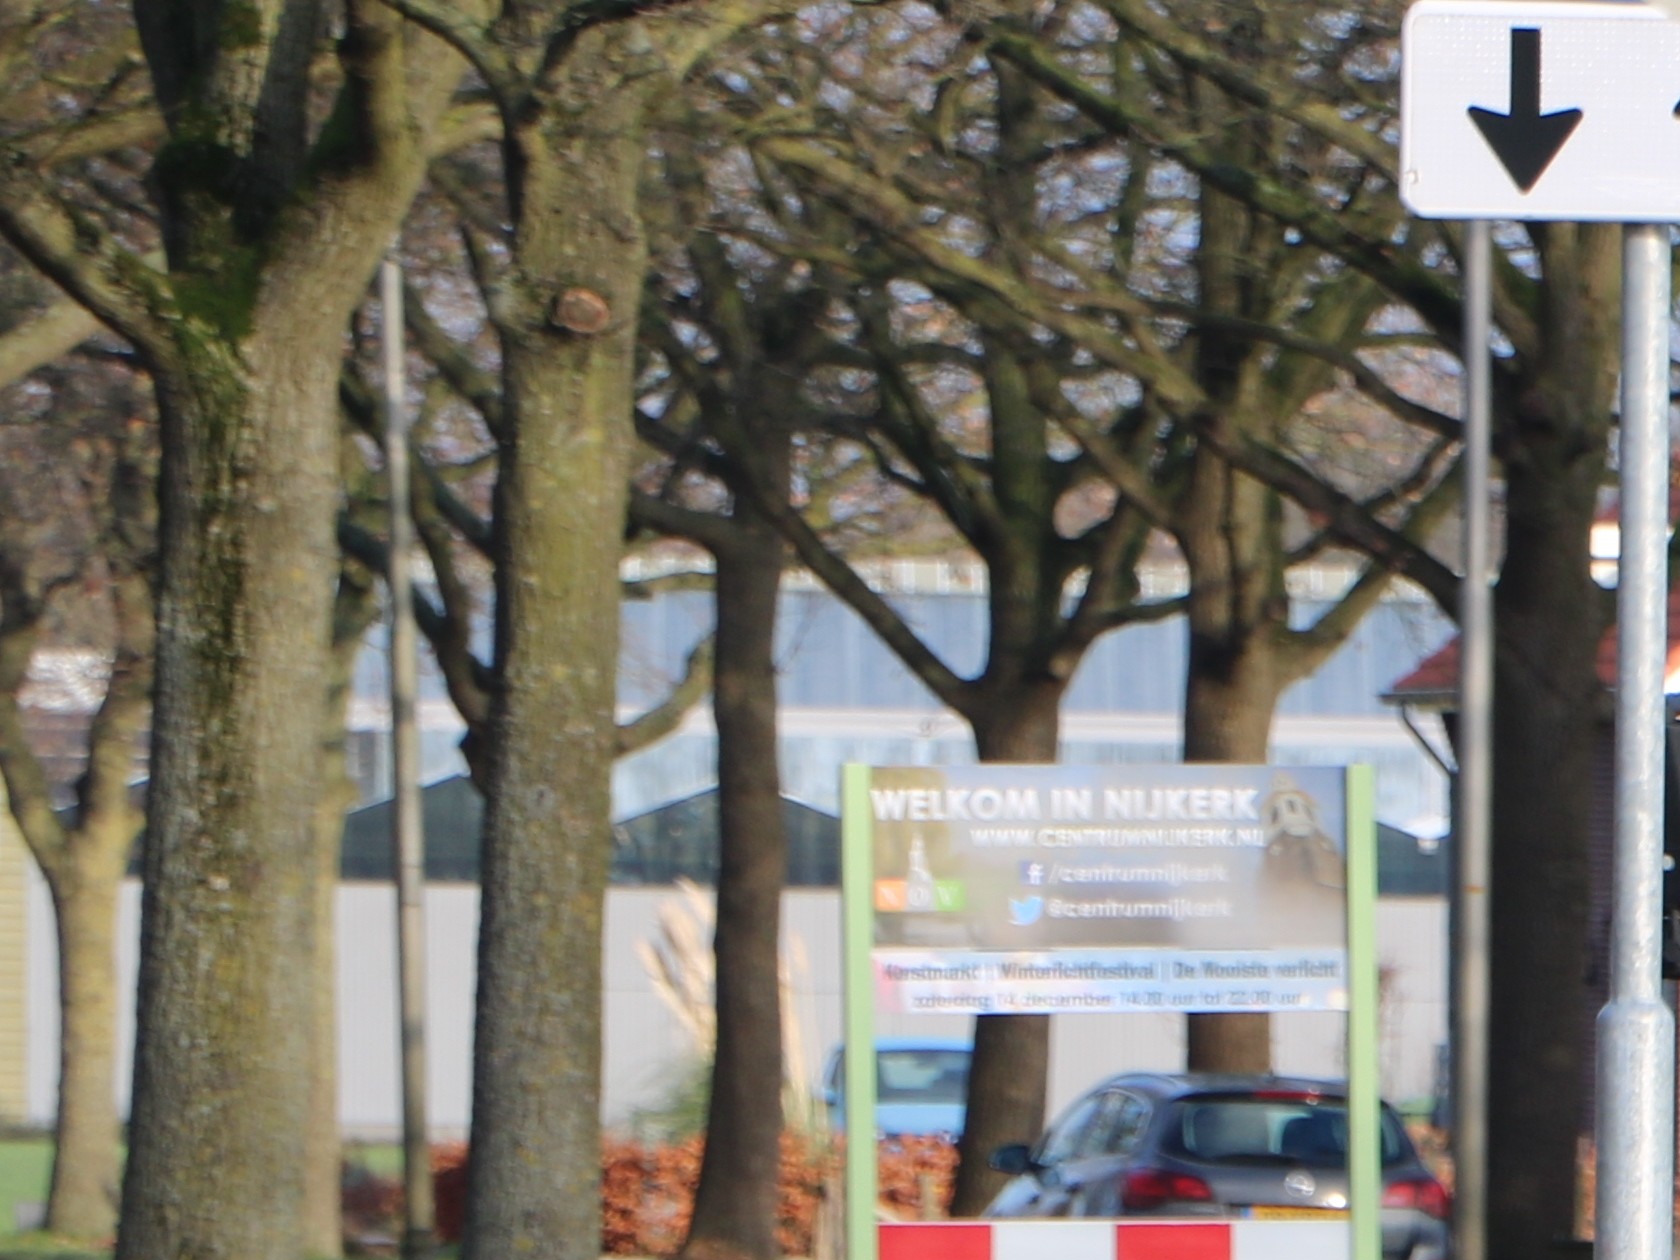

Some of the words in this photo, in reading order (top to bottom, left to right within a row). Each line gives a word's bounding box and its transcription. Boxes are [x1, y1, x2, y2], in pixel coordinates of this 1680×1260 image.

[869, 788, 1041, 821] WELKOM
[1050, 788, 1093, 820] IN
[1103, 787, 1259, 820] NIJKERK
